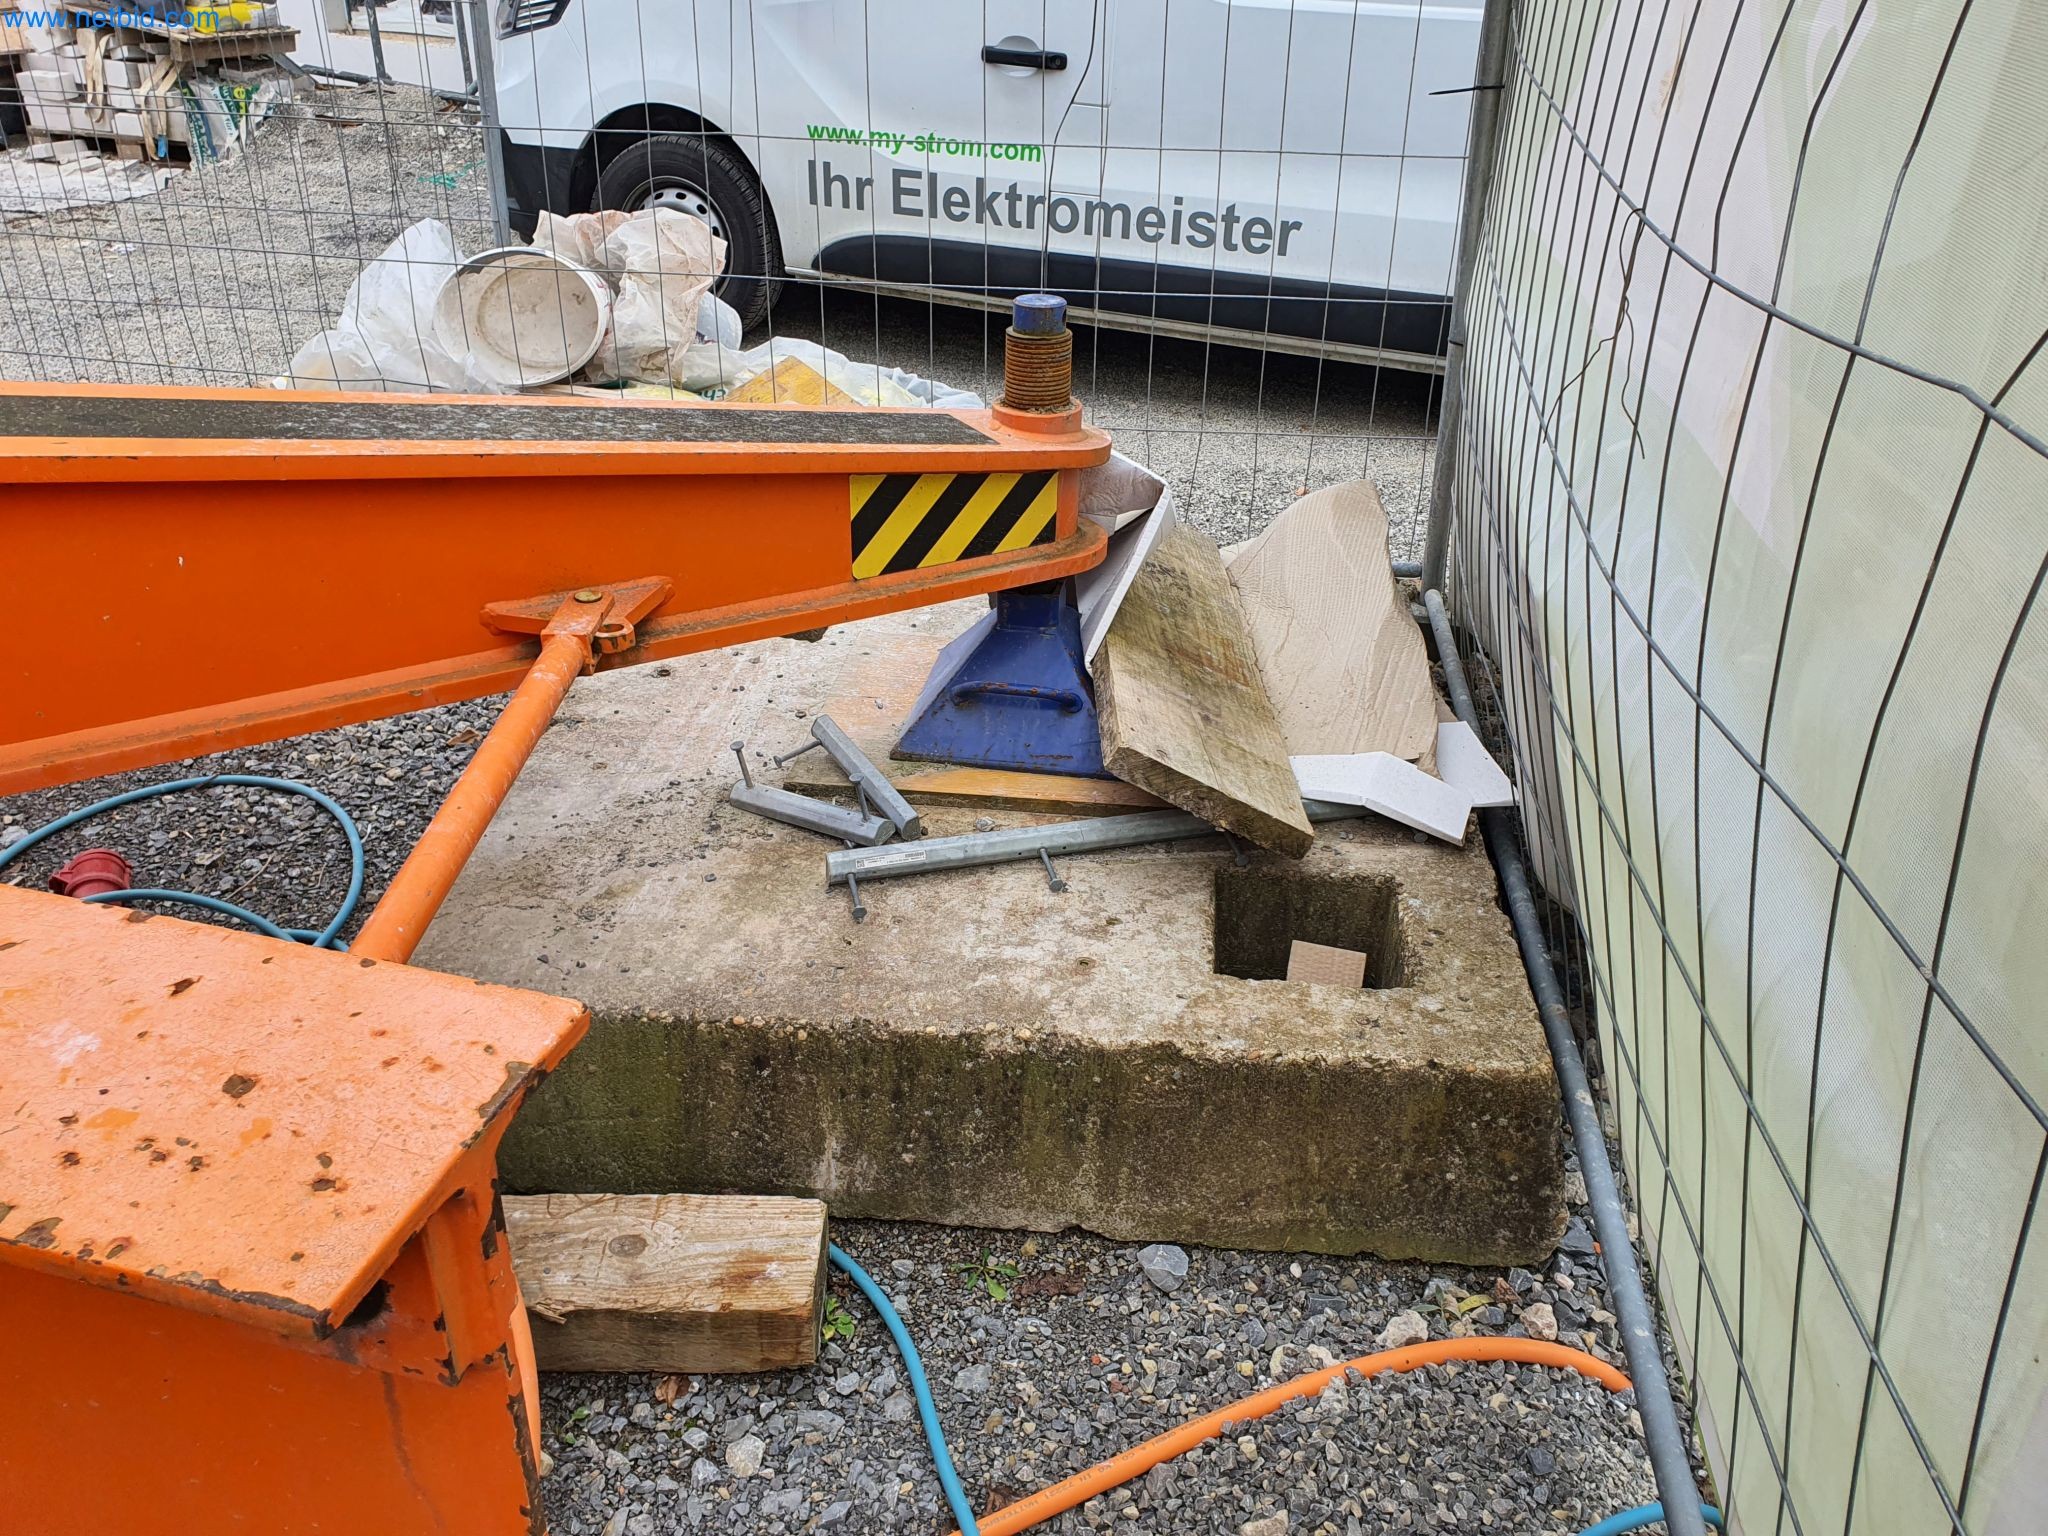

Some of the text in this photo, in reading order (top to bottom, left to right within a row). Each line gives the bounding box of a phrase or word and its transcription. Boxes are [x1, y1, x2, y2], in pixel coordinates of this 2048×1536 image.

[807, 124, 1042, 162] www.my-strom.com
[808, 159, 1303, 257] Ihr Elektromeister
